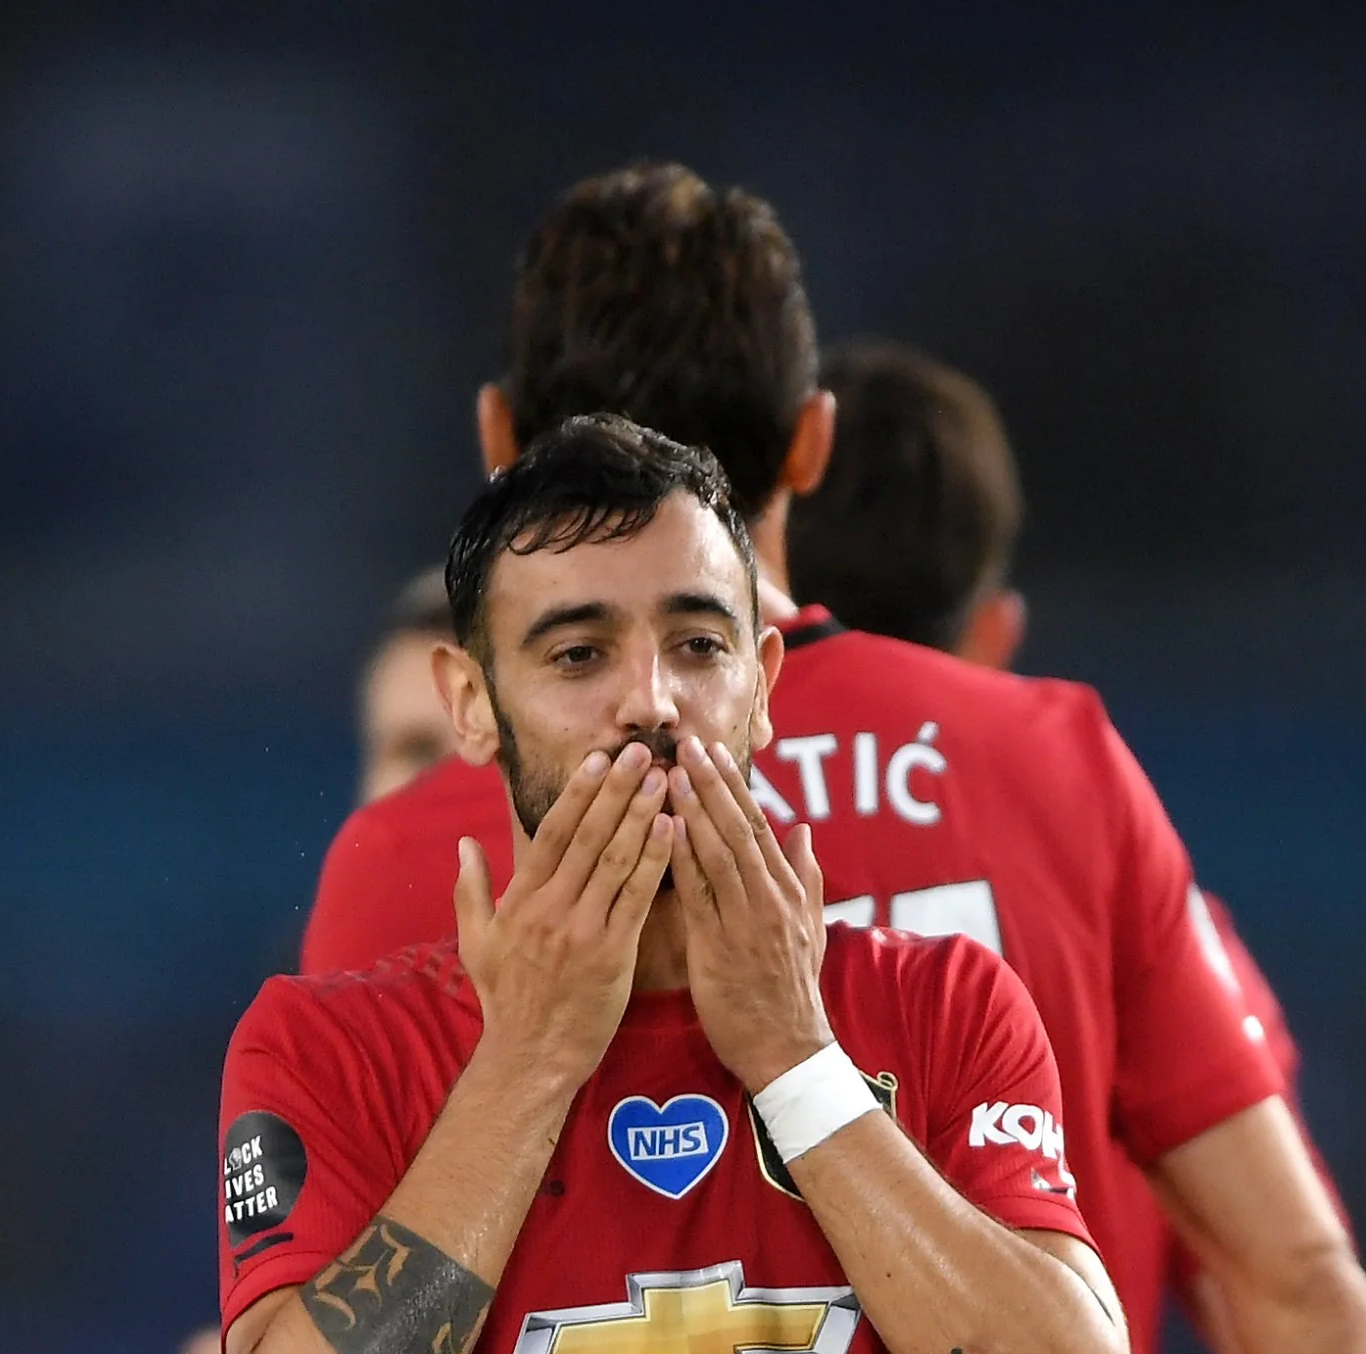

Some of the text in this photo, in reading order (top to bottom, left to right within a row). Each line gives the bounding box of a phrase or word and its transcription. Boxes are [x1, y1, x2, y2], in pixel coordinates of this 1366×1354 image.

[747, 721, 948, 825] ATIĆ
[224, 1135, 263, 1175] LCK
[633, 1126, 702, 1156] NHS
[968, 1100, 1076, 1188] KOH
[224, 1164, 265, 1199] IVES
[224, 1186, 278, 1223] ATTER
